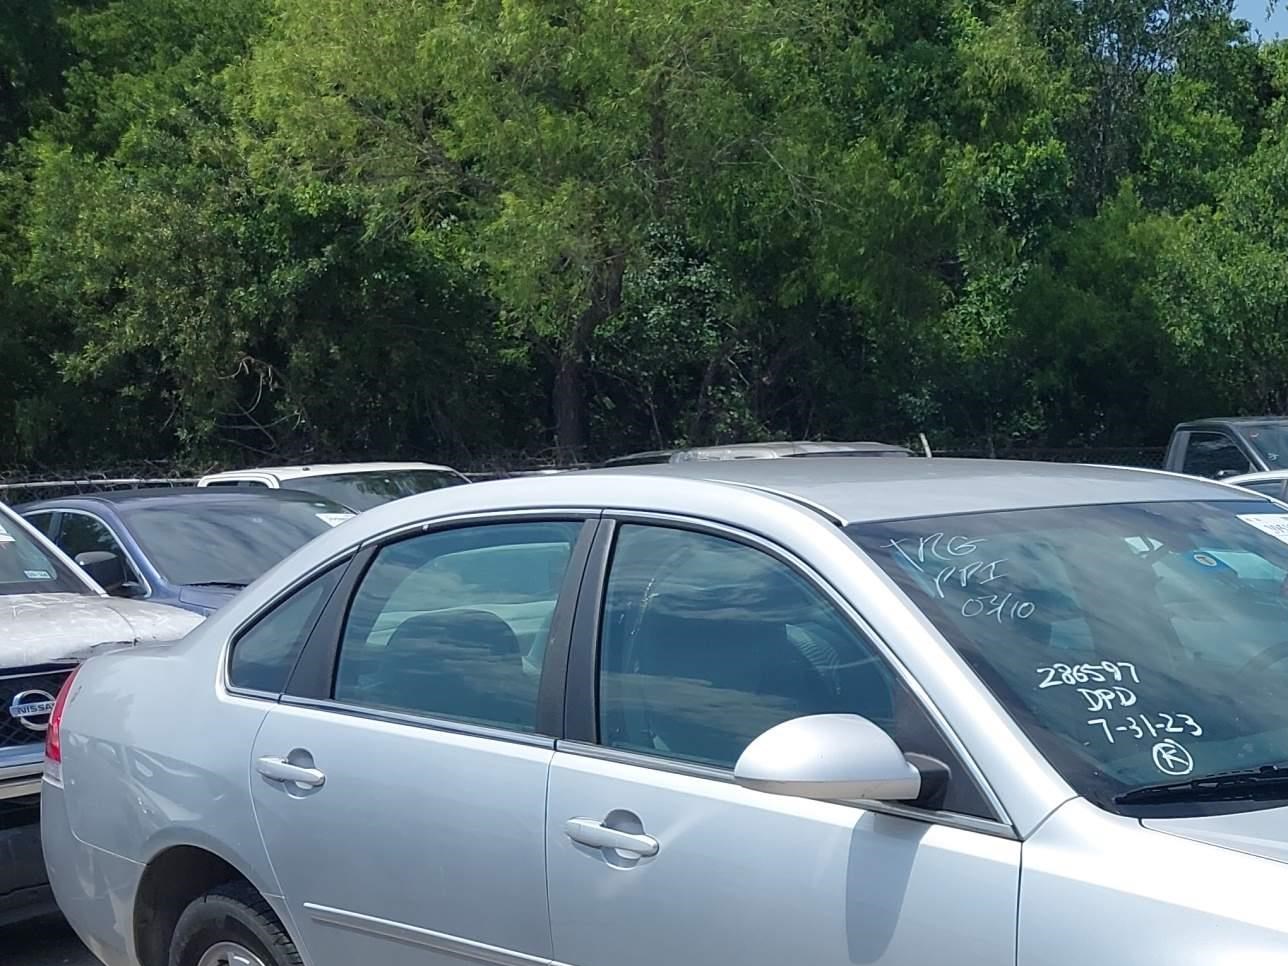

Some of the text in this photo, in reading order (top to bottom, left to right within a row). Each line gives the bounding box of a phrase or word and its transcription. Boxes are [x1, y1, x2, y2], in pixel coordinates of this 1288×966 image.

[1036, 660, 1140, 688] 286597
[18, 702, 55, 713] NISSA
[1076, 686, 1137, 711] DPD
[1087, 713, 1203, 744] 7-31-23
